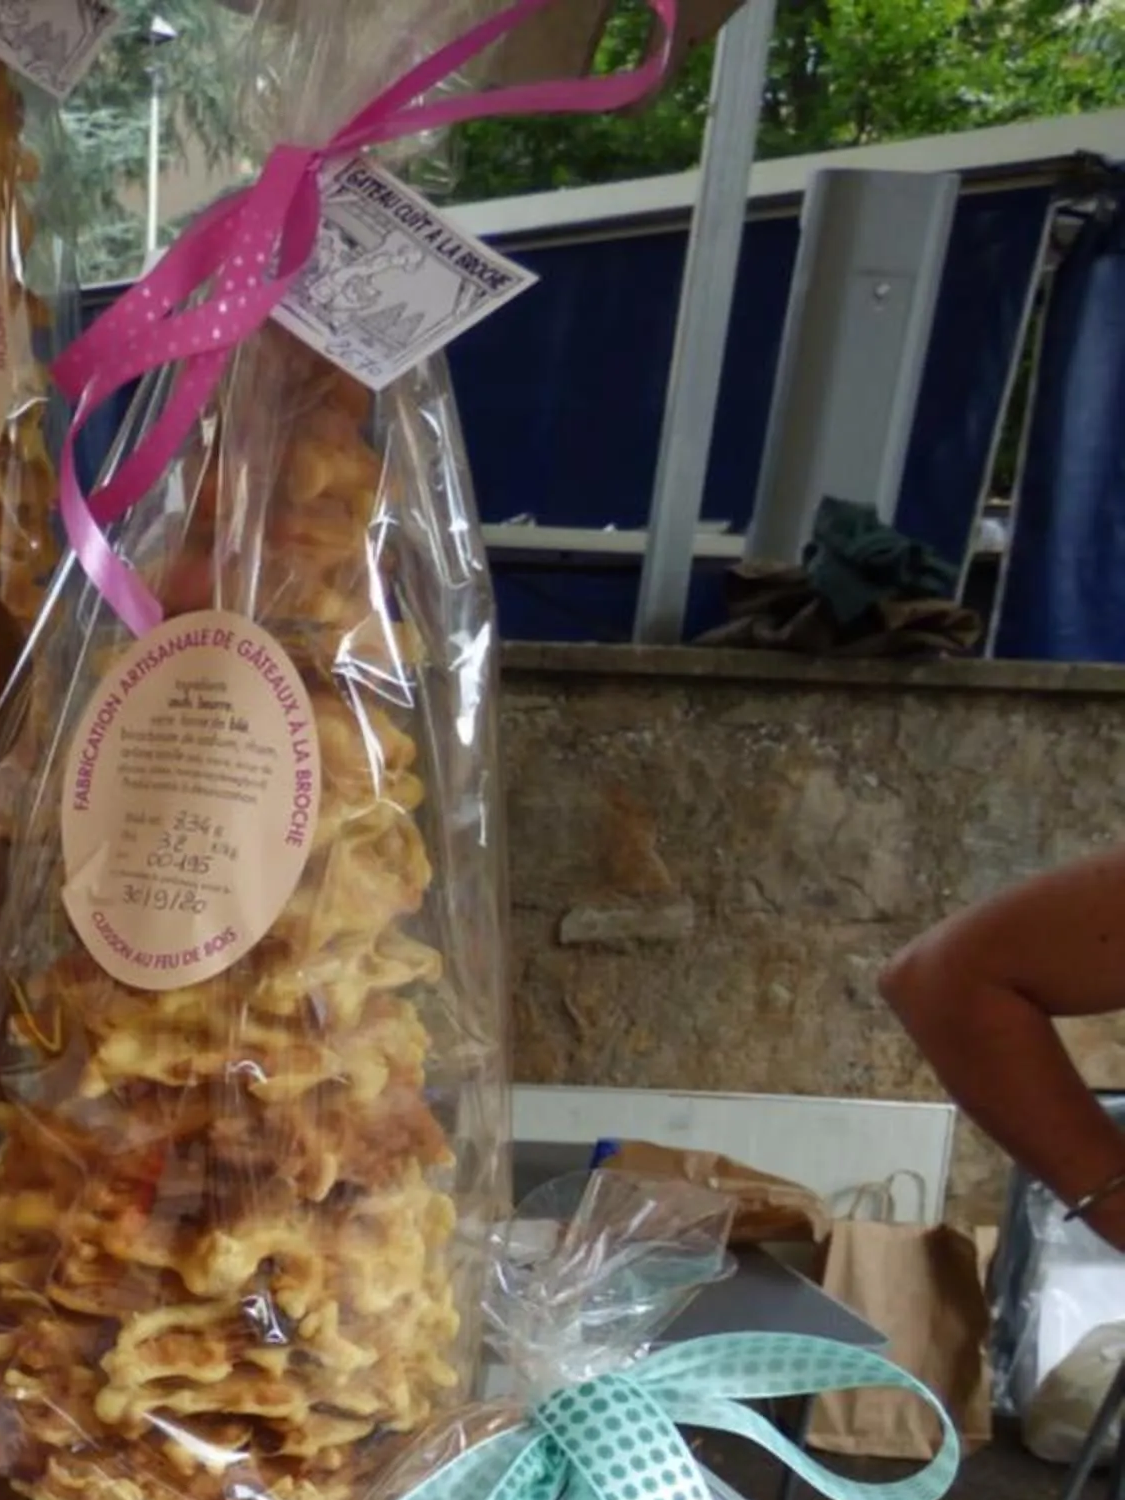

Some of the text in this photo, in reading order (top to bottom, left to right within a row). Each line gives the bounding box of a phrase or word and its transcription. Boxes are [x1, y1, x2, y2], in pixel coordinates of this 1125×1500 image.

[346, 169, 402, 209] GATEAU
[437, 237, 463, 259] LA
[454, 250, 512, 290] BROCHE
[120, 629, 211, 692] ARTISANALE
[212, 629, 234, 651] DE
[74, 696, 122, 810] FABRICATION
[292, 739, 310, 764] LA
[285, 769, 313, 848] BROCHE
[91, 911, 238, 970] CUISSON AU FEU DE BOIS
